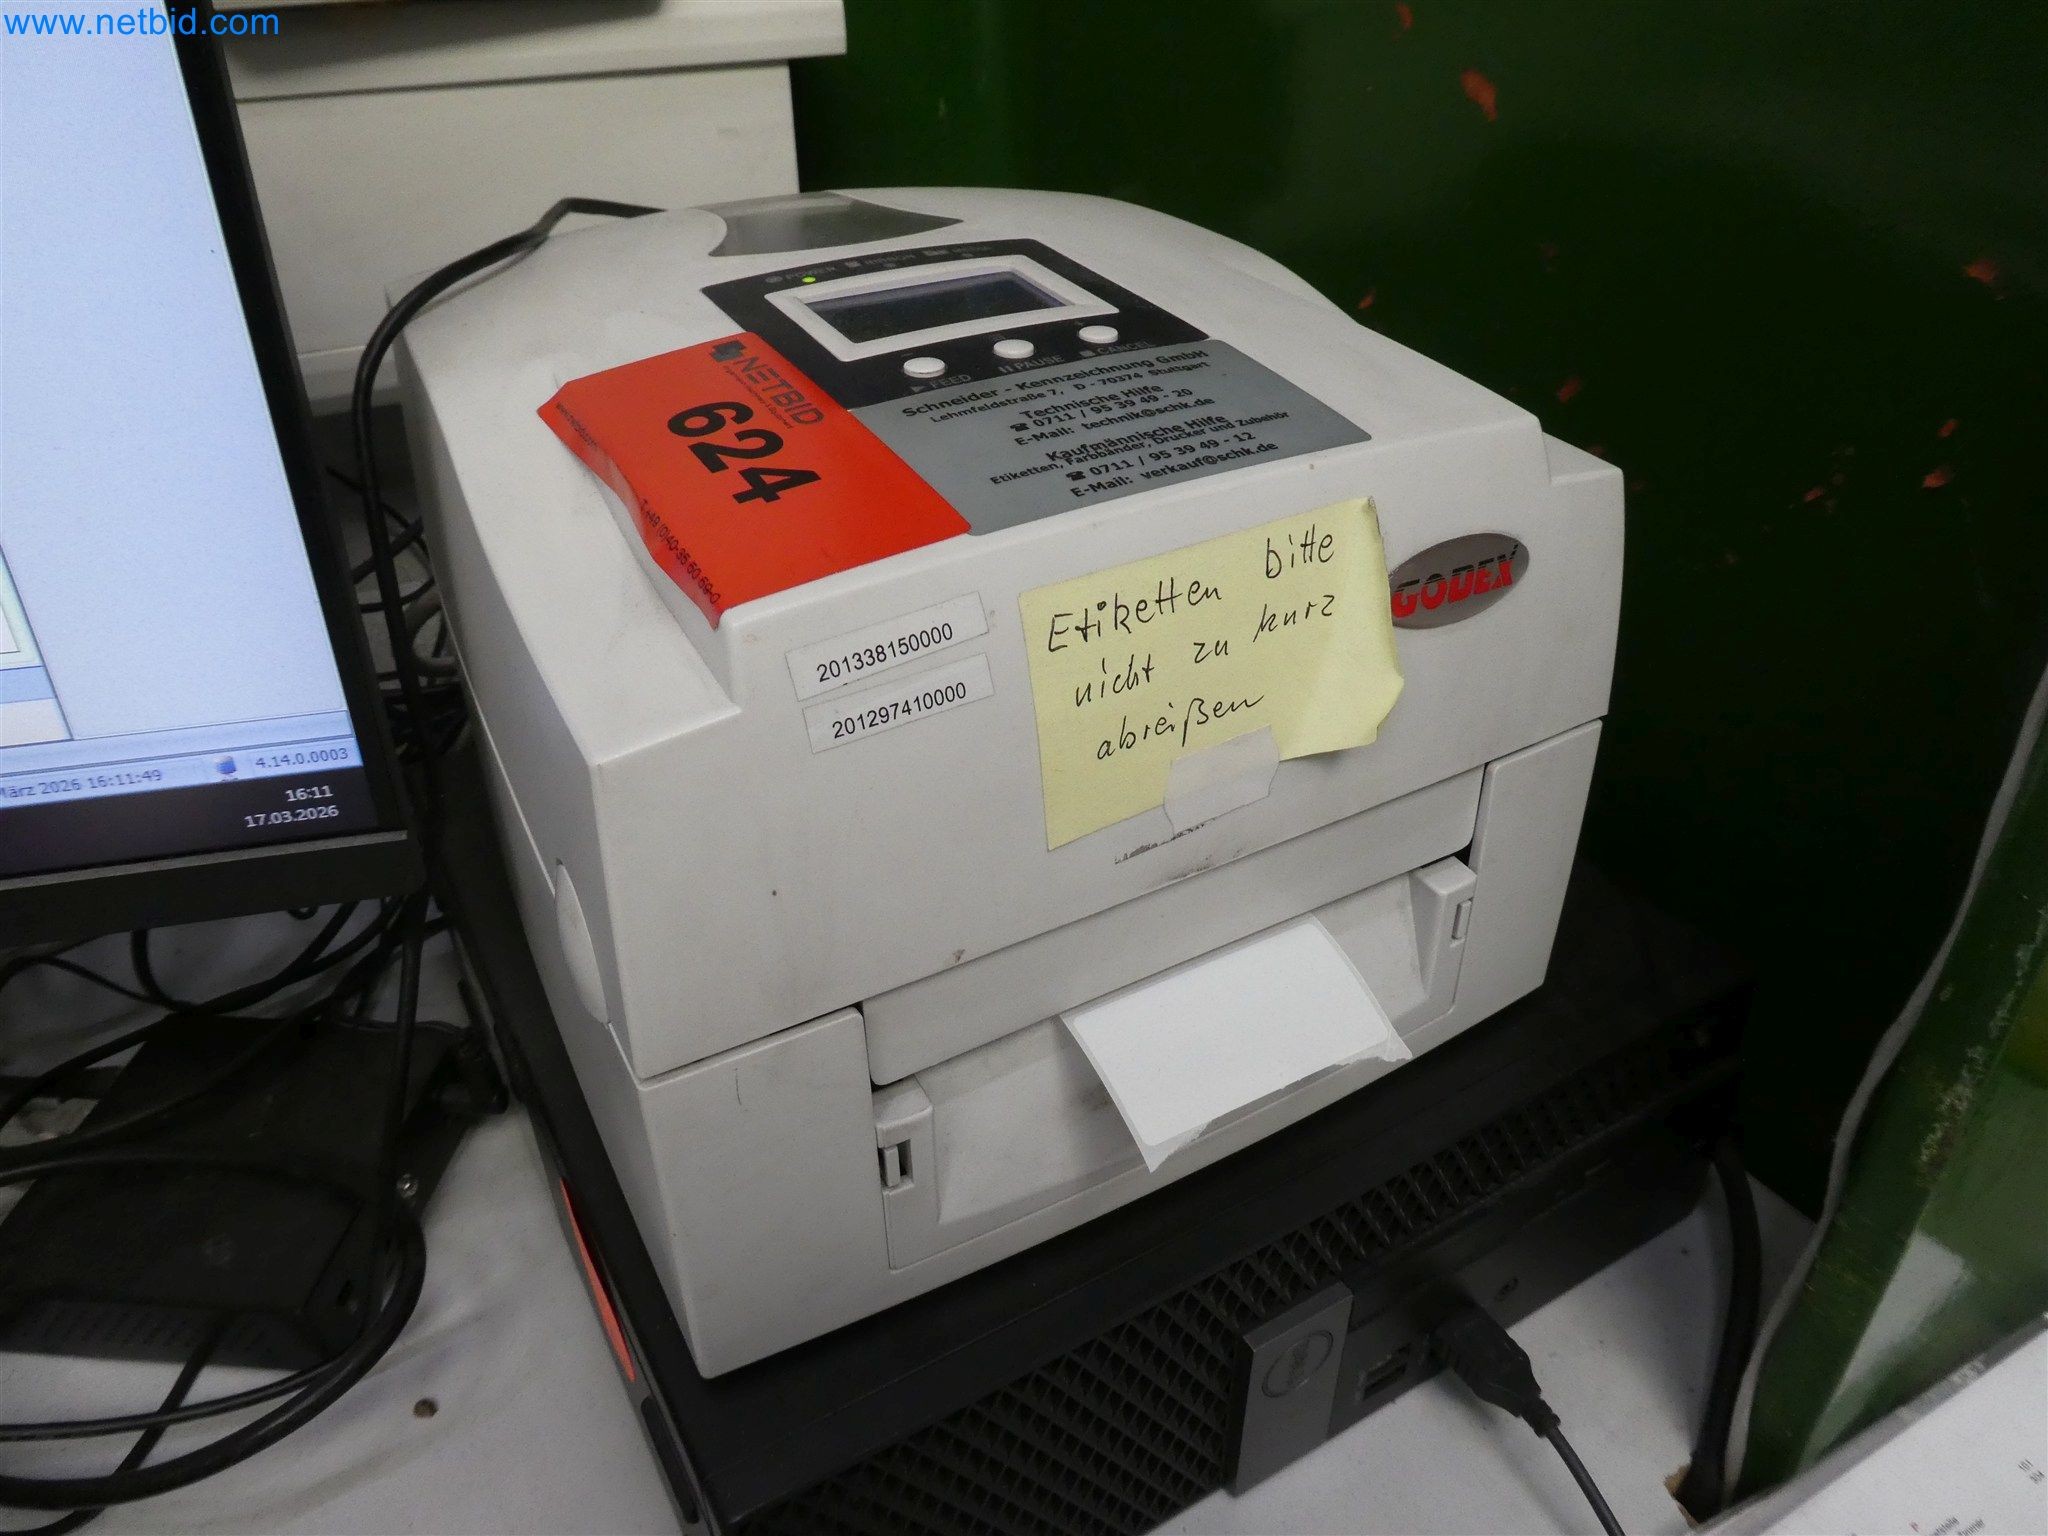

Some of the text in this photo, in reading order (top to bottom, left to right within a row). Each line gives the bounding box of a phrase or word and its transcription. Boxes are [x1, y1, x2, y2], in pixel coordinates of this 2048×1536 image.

[732, 356, 825, 425] NETBID
[902, 389, 999, 417] Schneider
[1015, 360, 1154, 391] Kennzeichnung
[1156, 350, 1209, 364] GmbH
[929, 374, 972, 390] FEED
[1015, 354, 1066, 373] PAUSE
[930, 392, 1046, 423] Lehmfeldstraße
[1073, 383, 1086, 391] D
[1097, 372, 1143, 386] 70374
[1148, 361, 1210, 376] Stuttgart
[1019, 384, 1164, 420] Technische Hilfe
[1032, 412, 1076, 427] 0711
[1090, 404, 1113, 415] 95
[1115, 399, 1136, 410] 39
[1140, 394, 1160, 404] 49
[1171, 388, 1194, 398] 20
[990, 411, 1289, 485] Etiketten, Farbbänder, Drucker und Zubehör
[1014, 397, 1215, 446] E-Mail: technik@schk.de
[1045, 415, 1229, 462] Kaufmännische Hilfe
[667, 401, 822, 504] 624
[1070, 442, 1278, 498] E-Mail: verkauf@schk.de
[1089, 459, 1134, 476] 0711
[1149, 450, 1172, 462] 95
[1173, 444, 1196, 456] 39
[1200, 439, 1220, 450] 49
[1233, 432, 1256, 443] 12
[1048, 524, 1335, 653] Etiketten bitte
[1391, 543, 1518, 618] GODEX
[816, 622, 953, 683] 201338150000
[1075, 594, 1336, 707] nicht zu kurz
[832, 682, 967, 739] 201297410000
[1097, 695, 1265, 760] abreißen
[38, 779, 82, 794] 2026
[88, 769, 163, 789] 16:11:49
[256, 748, 349, 768] 4.14.0.0003
[244, 805, 340, 828] 17.03.2026
[285, 785, 334, 802] 16:11
